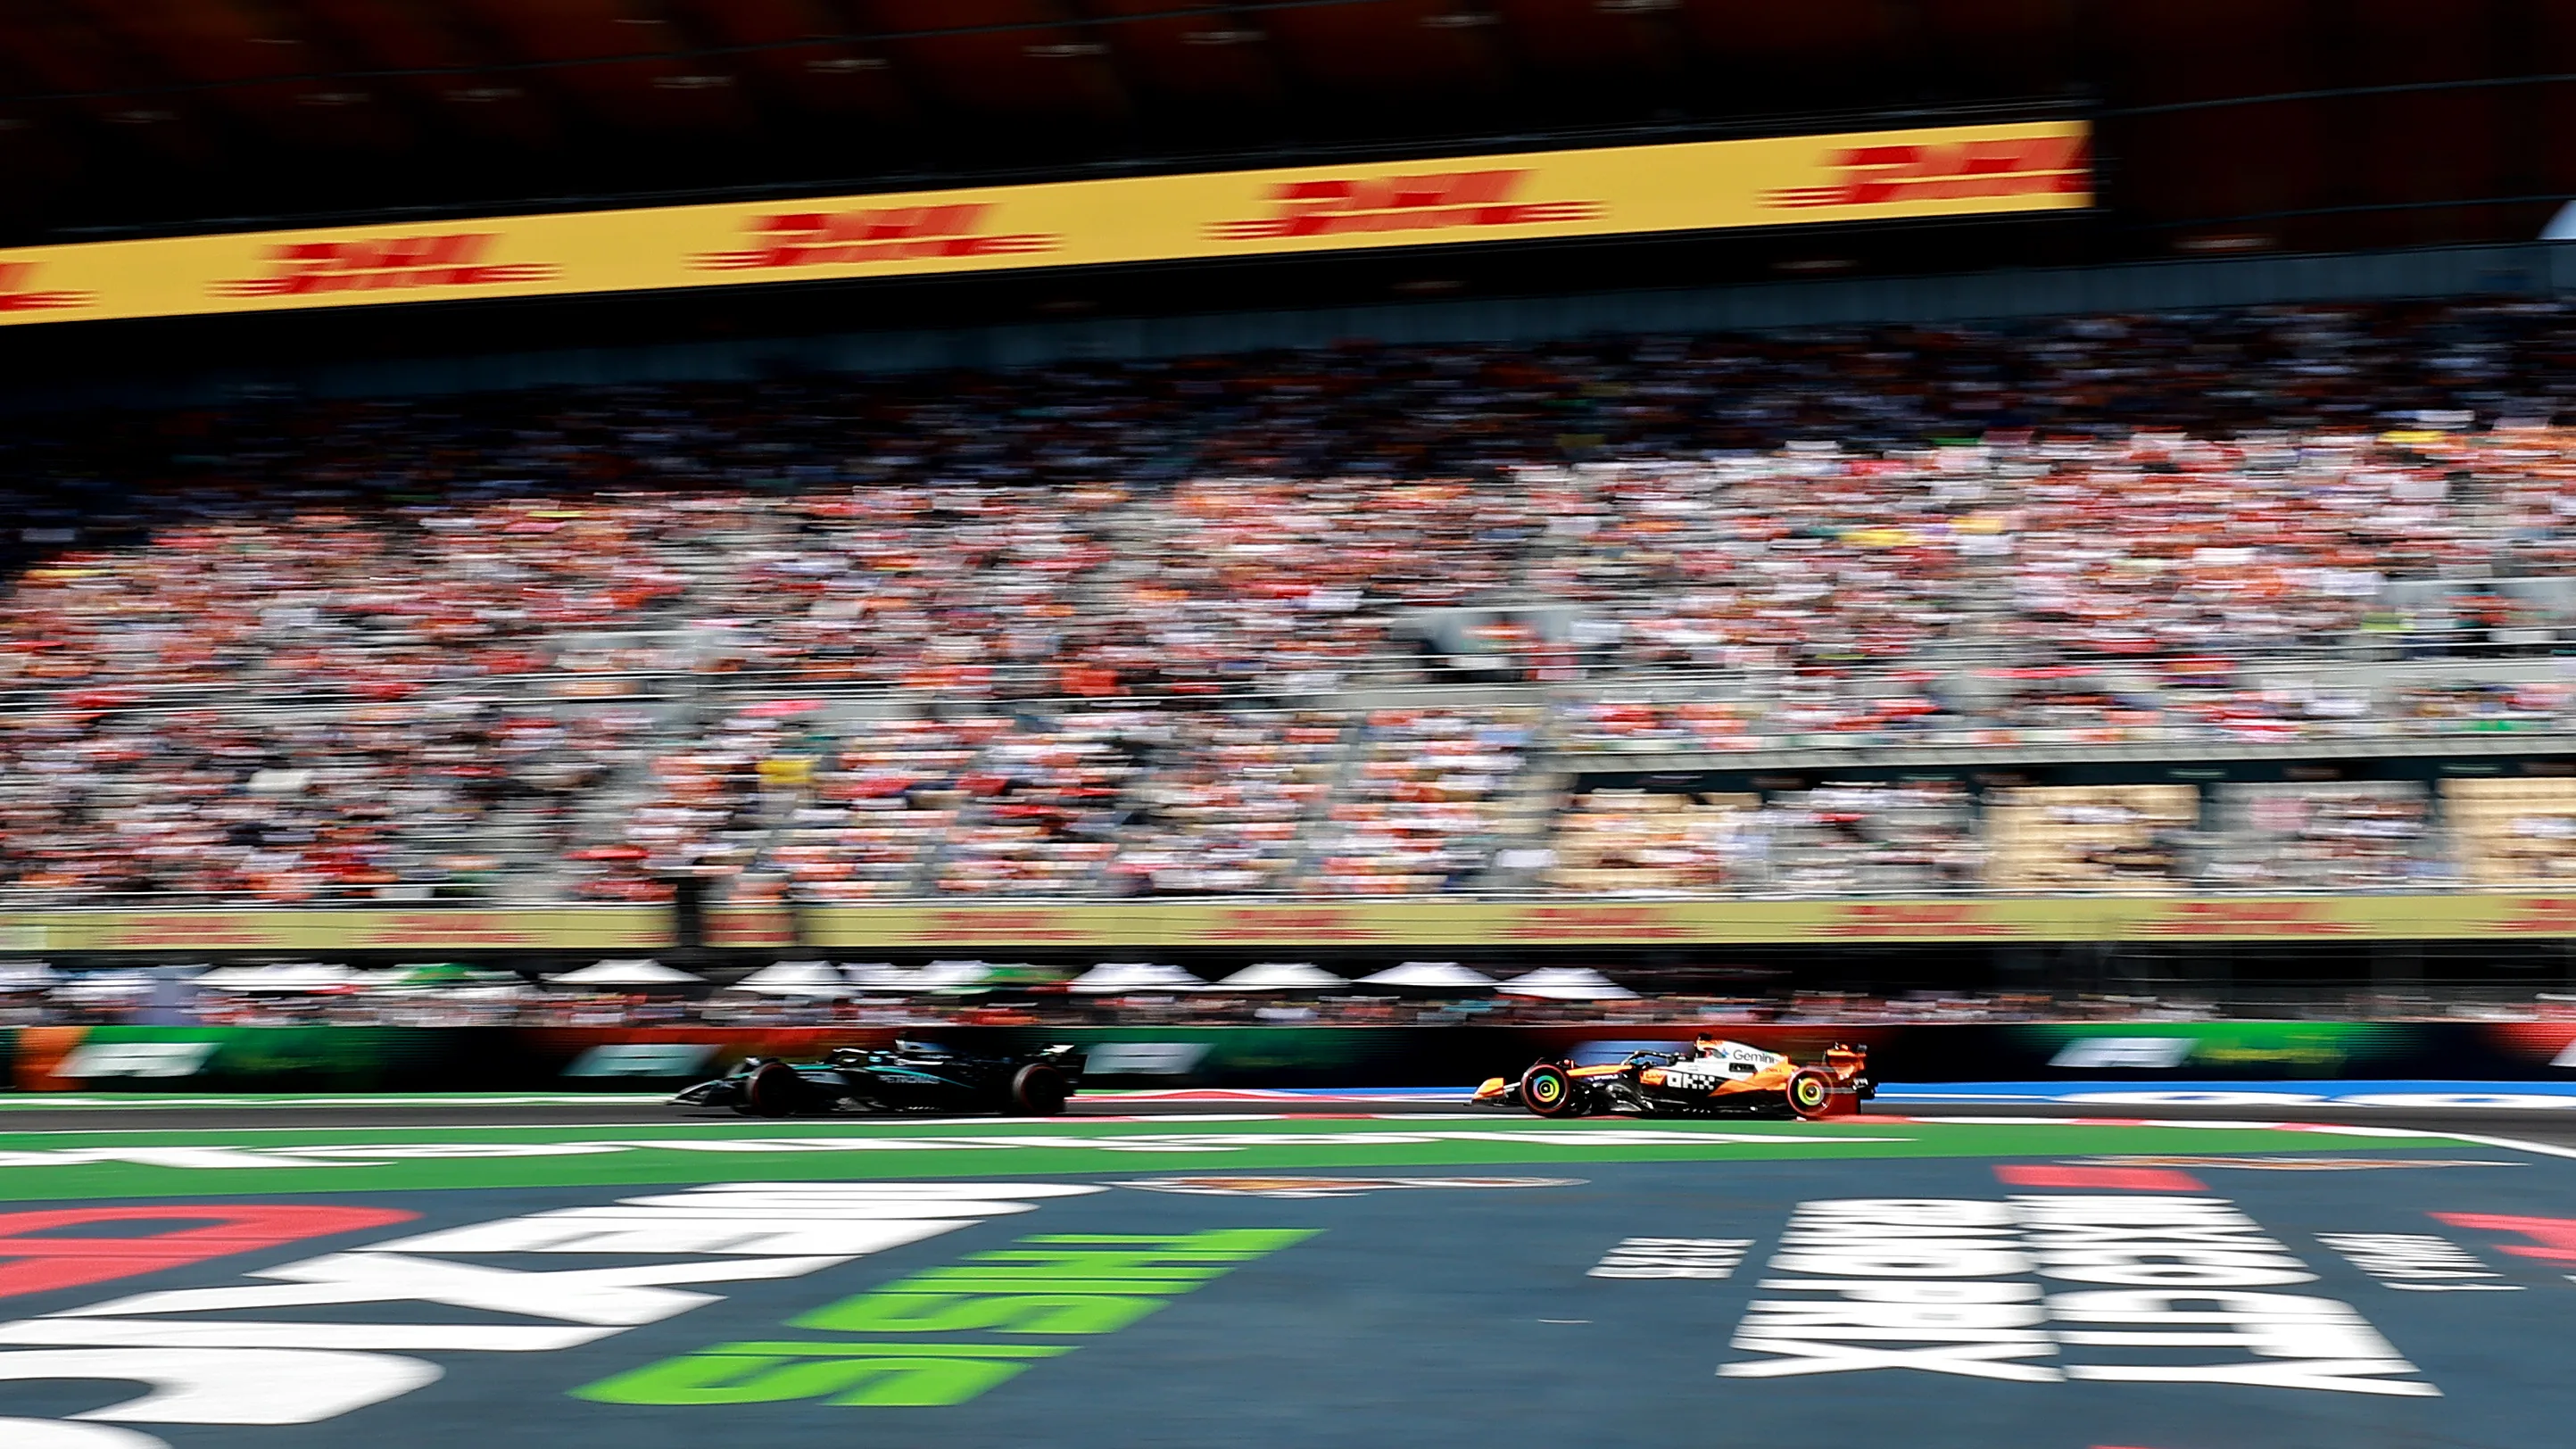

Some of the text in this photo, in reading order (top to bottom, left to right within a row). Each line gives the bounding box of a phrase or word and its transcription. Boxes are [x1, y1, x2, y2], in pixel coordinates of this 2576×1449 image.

[1666, 1072, 1716, 1090] OKX
[1733, 1049, 1777, 1064] Gemini
[1585, 1238, 1757, 1279] 2025
[1766, 1198, 2038, 1278] GRAND
[2004, 1195, 2322, 1286] MEXICO
[565, 1229, 1322, 1407] THIS IS
[1715, 1279, 2067, 1383] PRIX
[2043, 1289, 2445, 1397] CITY
